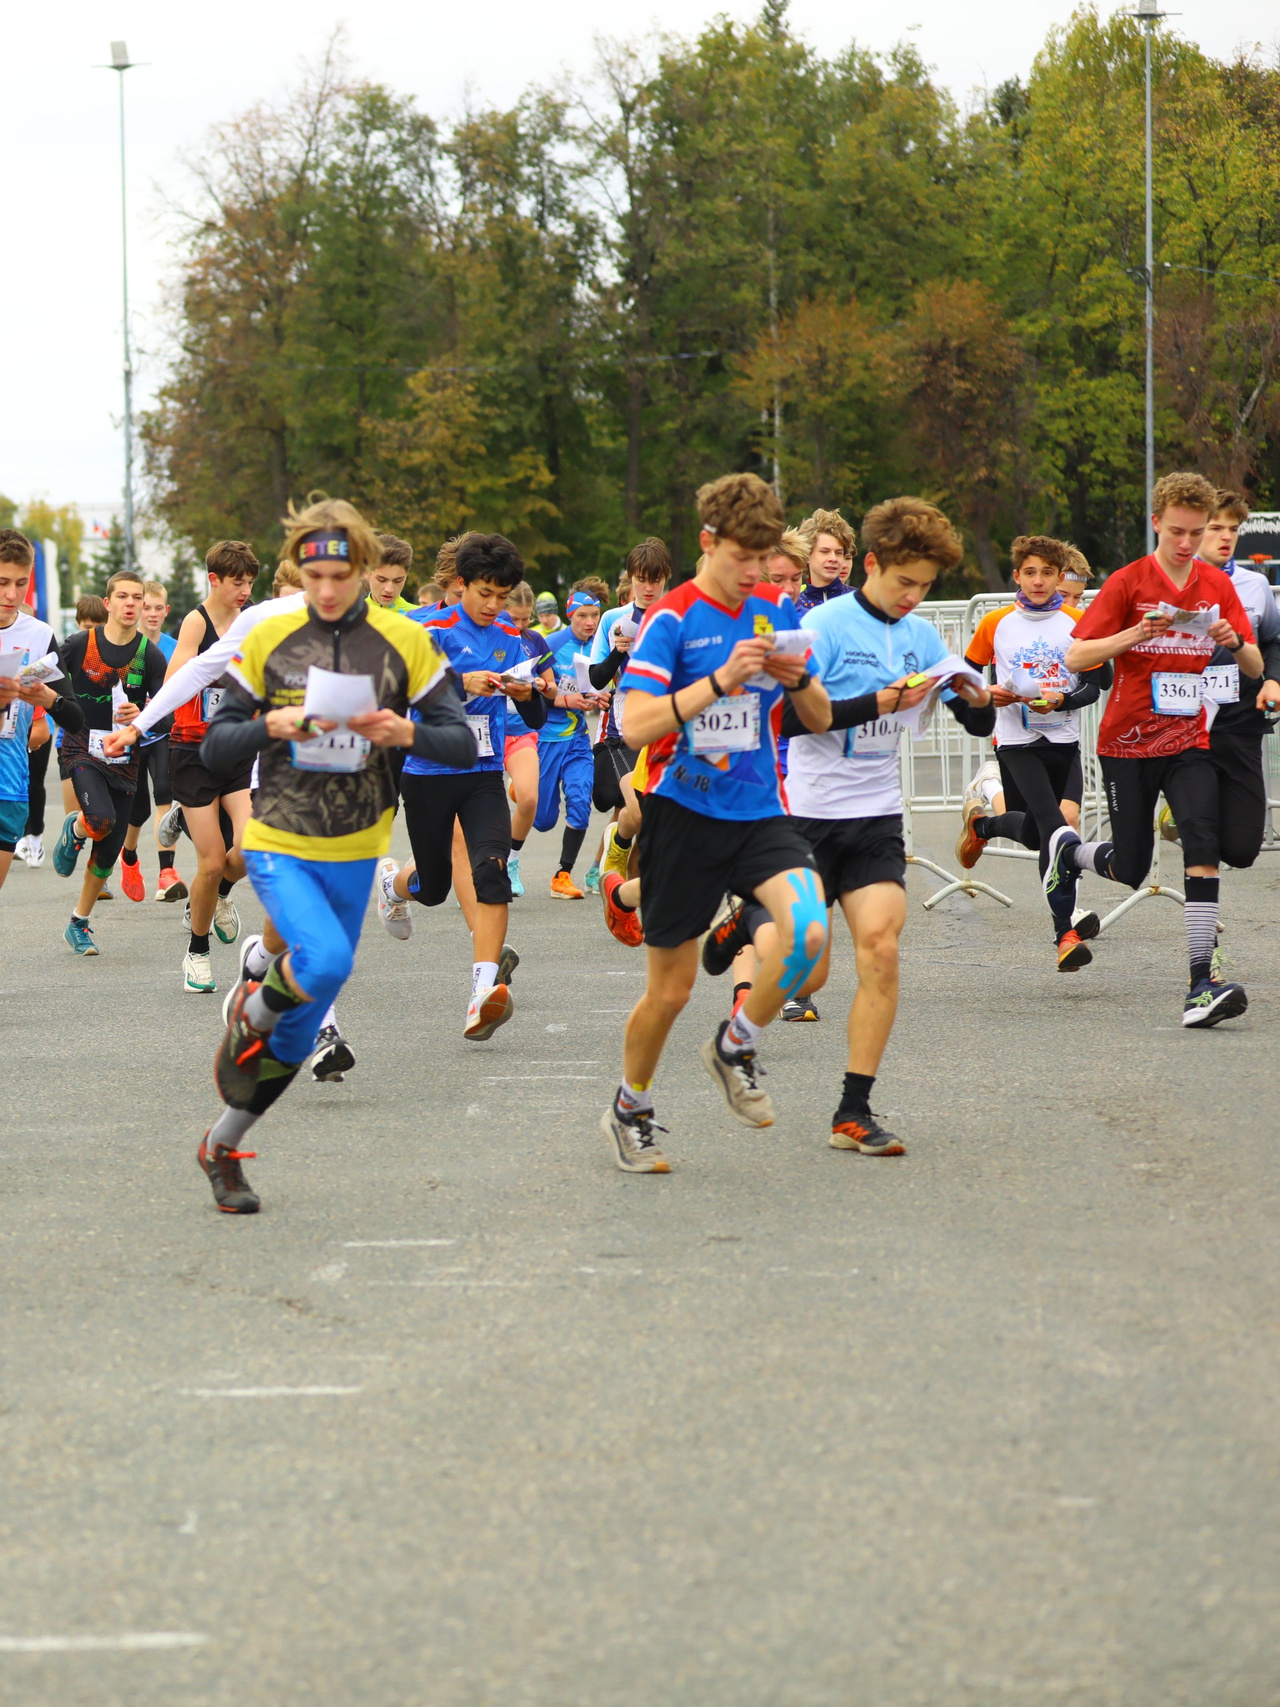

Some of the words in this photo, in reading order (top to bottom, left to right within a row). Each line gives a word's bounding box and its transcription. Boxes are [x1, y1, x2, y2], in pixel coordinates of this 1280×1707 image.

[1160, 683, 1197, 699] 336.1
[1201, 675, 1231, 690] 37.1
[694, 711, 750, 732] 302.1
[858, 719, 899, 739] 310.1
[692, 772, 711, 793] 18
